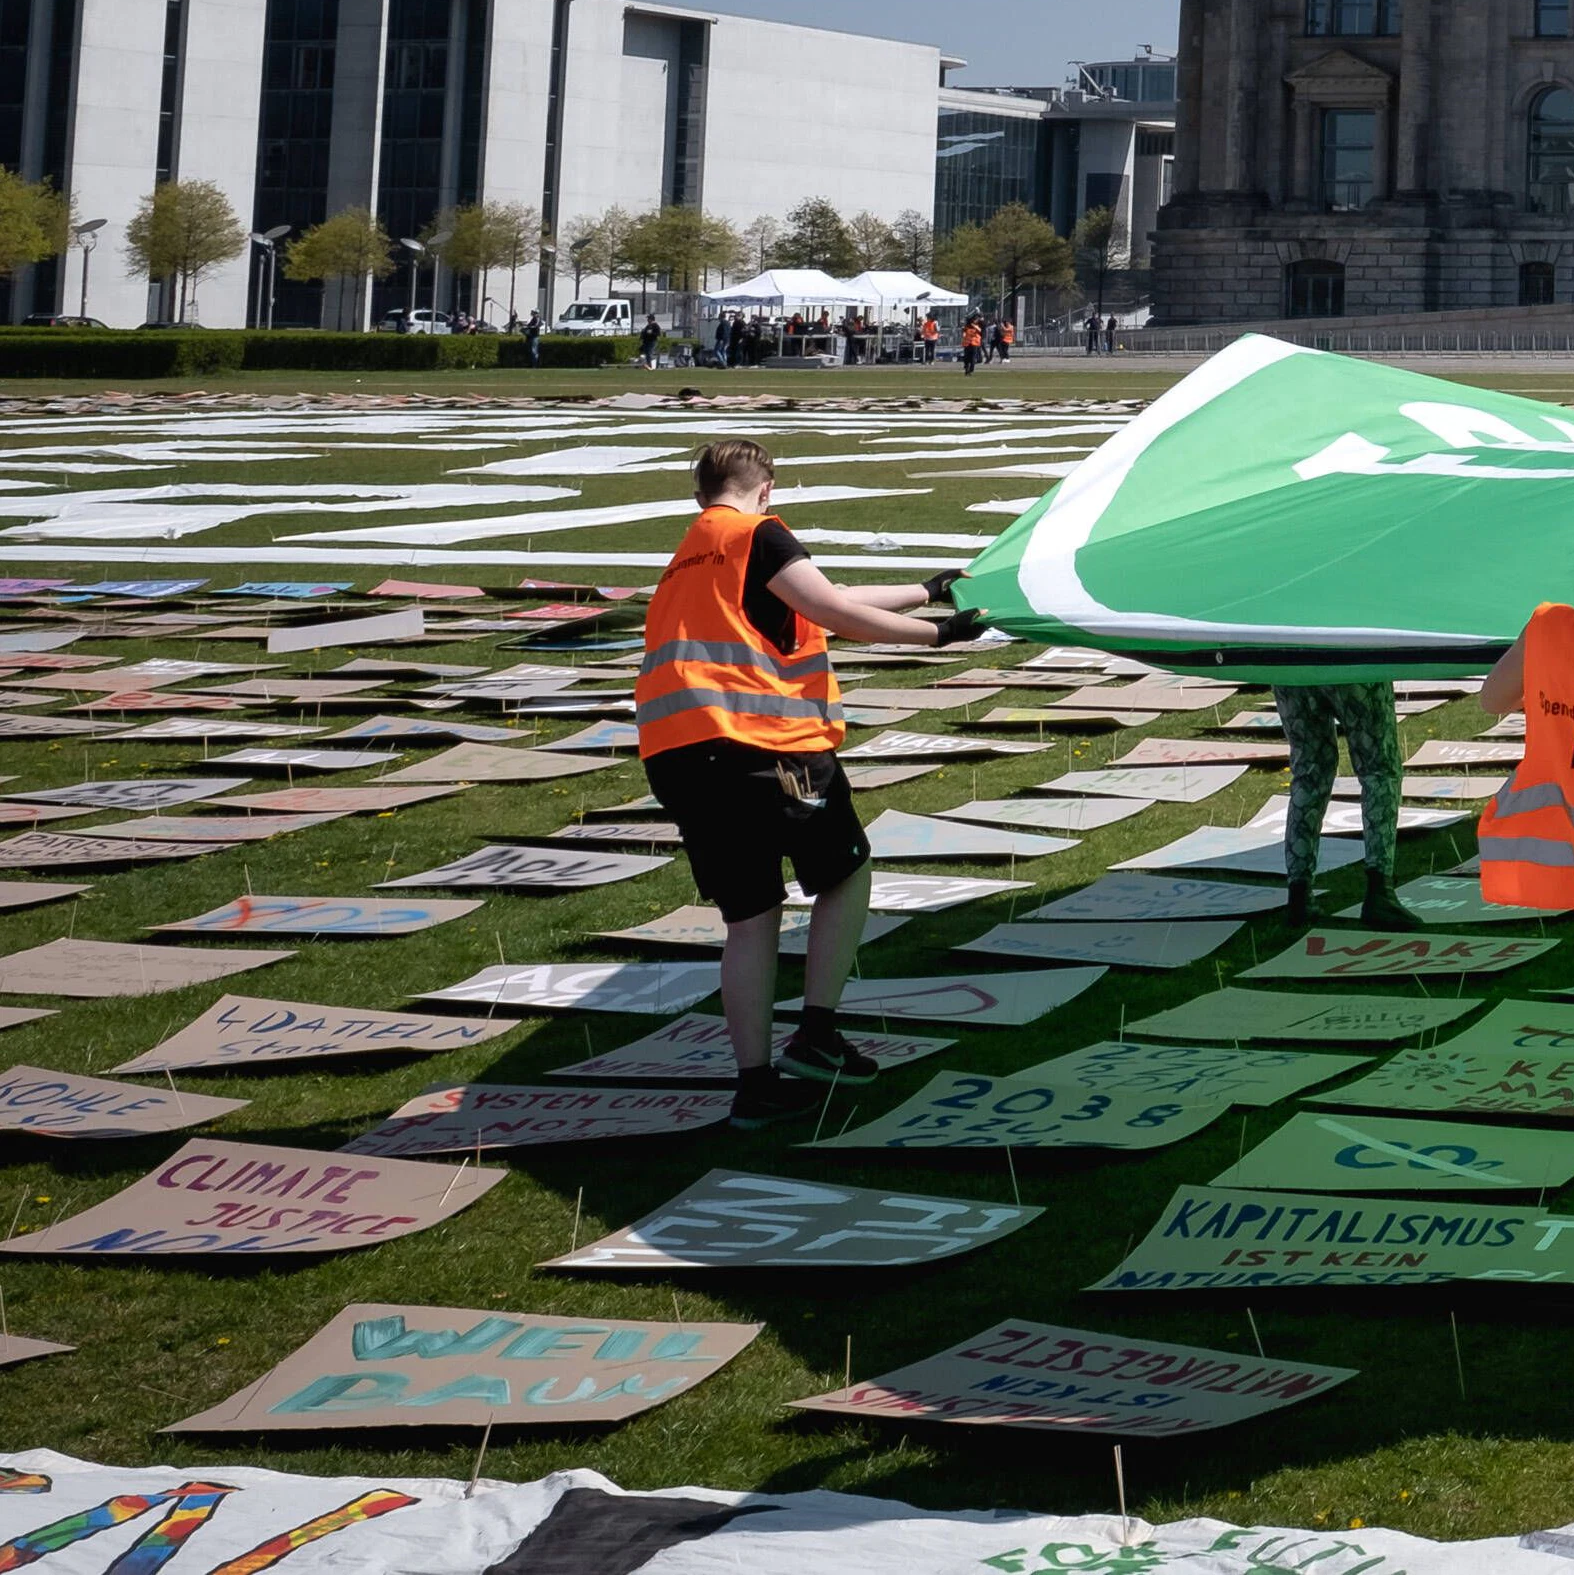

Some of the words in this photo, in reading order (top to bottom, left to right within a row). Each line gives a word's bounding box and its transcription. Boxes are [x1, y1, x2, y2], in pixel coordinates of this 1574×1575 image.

[930, 1076, 1185, 1129] 2038
[156, 1153, 385, 1206] CLIMATE
[184, 1200, 420, 1237] JUSTICE
[1160, 1197, 1527, 1248] KAPITALISMUS
[1216, 1246, 1313, 1268] IST
[1316, 1249, 1427, 1269] KEIN
[955, 1329, 1322, 1401] NATURGESETZ
